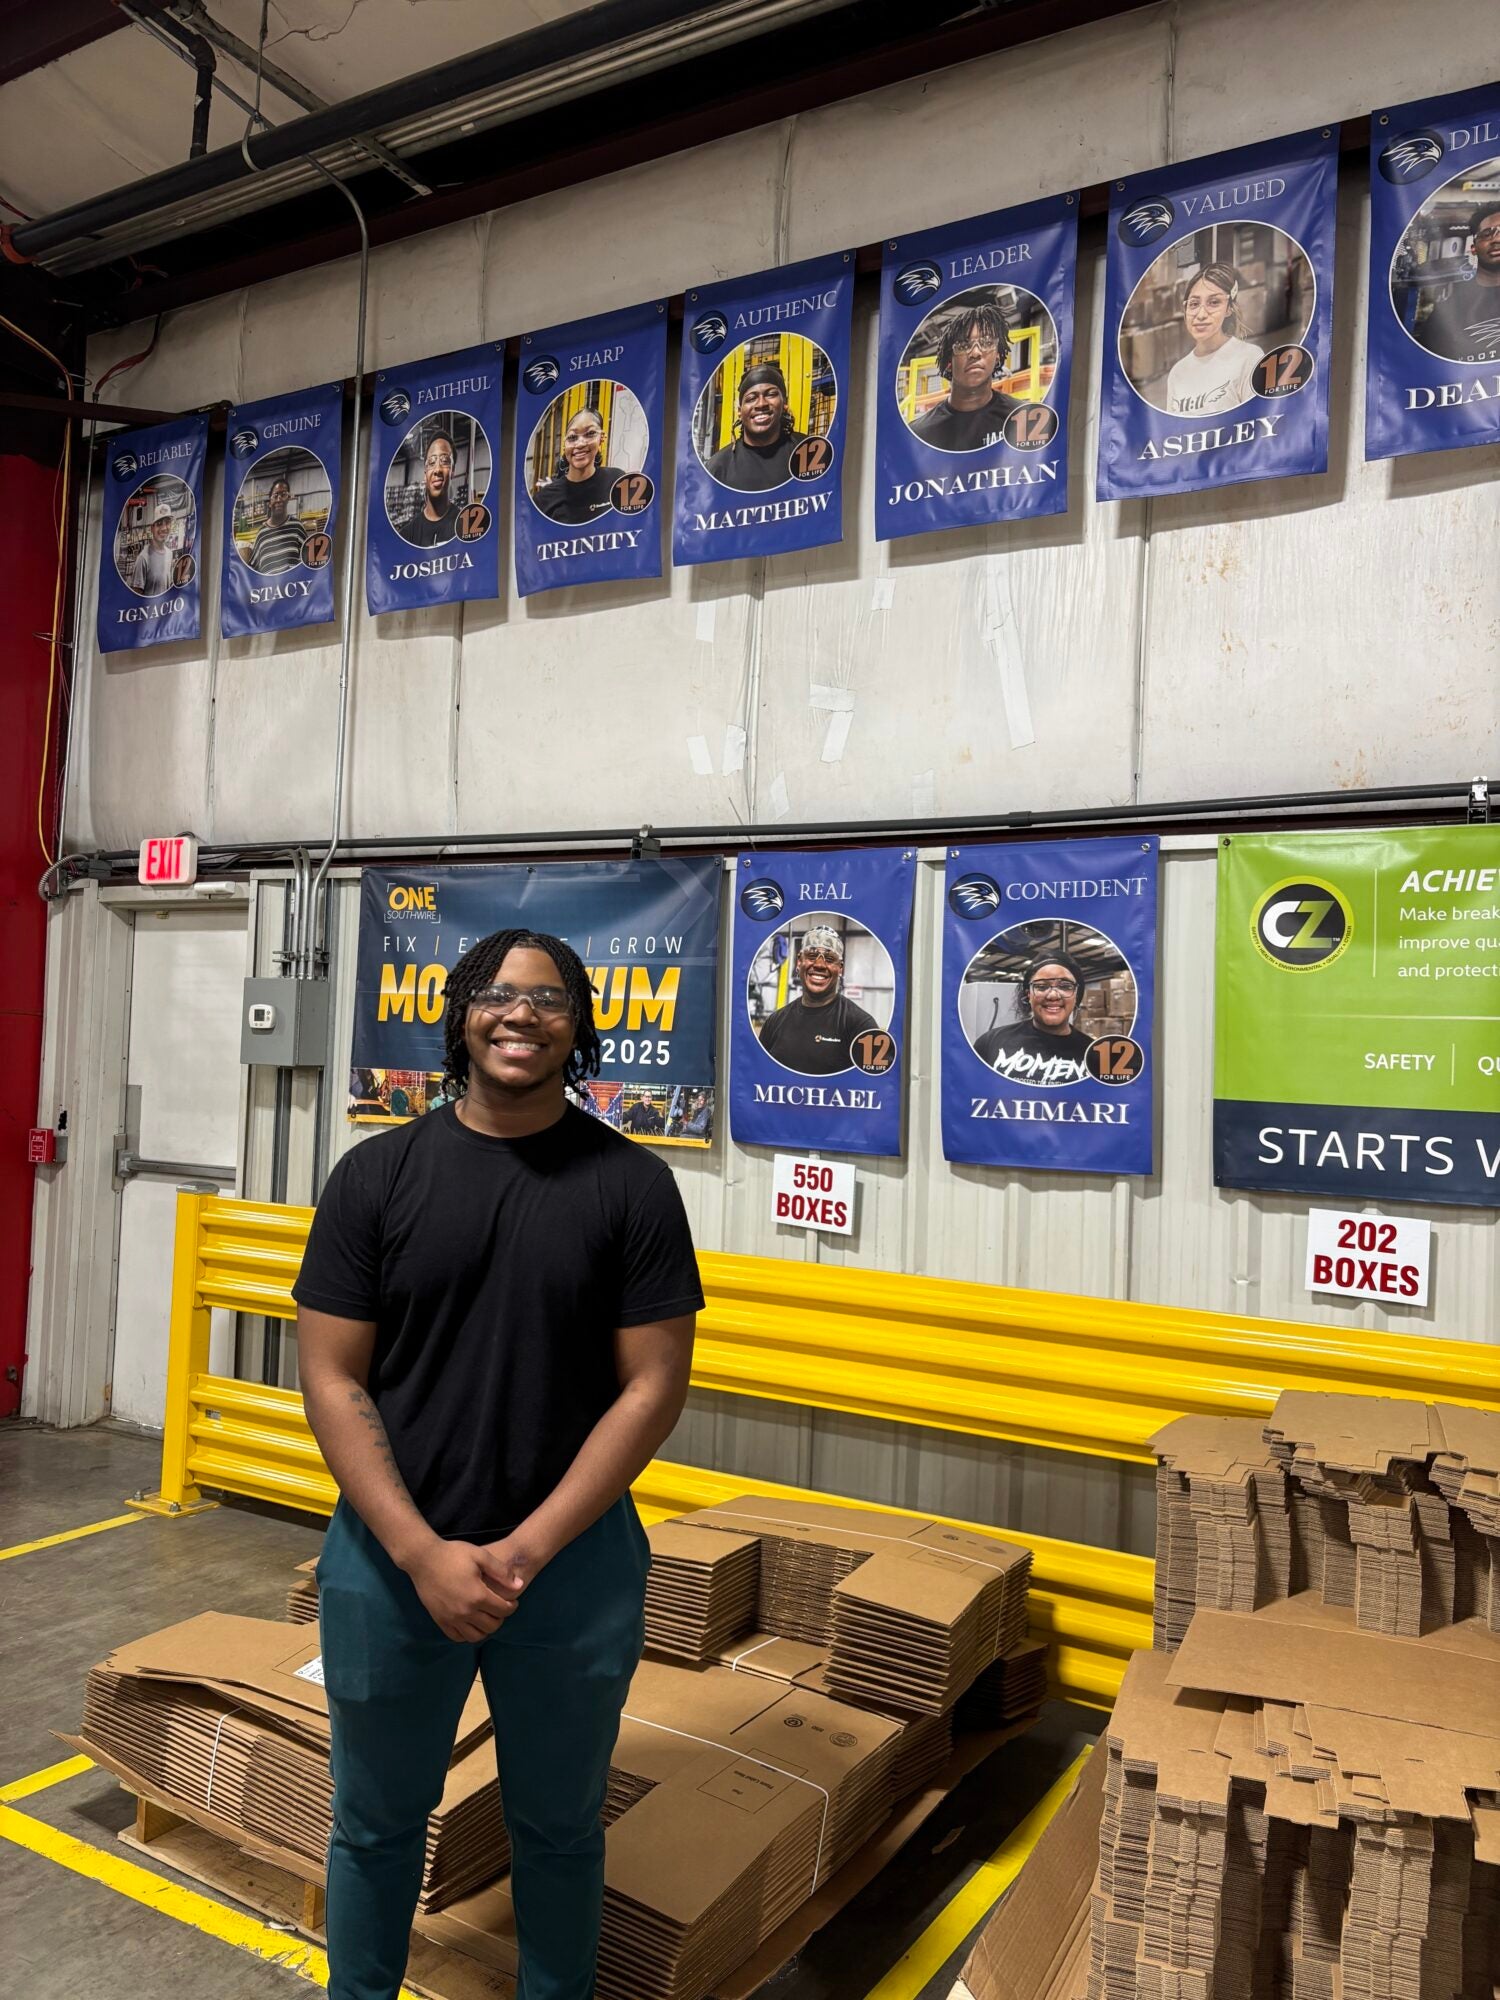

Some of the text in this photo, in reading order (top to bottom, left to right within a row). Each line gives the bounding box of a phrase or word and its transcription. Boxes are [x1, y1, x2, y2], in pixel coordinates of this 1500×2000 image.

[1448, 121, 1499, 152] DIL
[1181, 177, 1286, 217] VALUED
[950, 242, 1033, 279] LEADER
[734, 290, 838, 330] AUTHENIC
[569, 345, 625, 373] SHARP
[1259, 347, 1304, 390] 12
[416, 375, 491, 405] FAITHFUL
[1264, 383, 1299, 395] FOR LIFE
[1404, 375, 1500, 411] DEA
[263, 413, 322, 440] GENUINE
[1010, 407, 1051, 443] 12
[1137, 414, 1285, 461] ASHLEY
[139, 441, 193, 468] RELIABLE
[795, 439, 827, 473] 12
[615, 476, 648, 507] 12
[888, 459, 1060, 506] JONATHAN
[459, 506, 485, 535] 12
[692, 491, 834, 532] MATTHEW
[305, 535, 330, 562] 12
[536, 529, 644, 562] TRINITY
[389, 551, 475, 582] JOSHUA
[249, 579, 314, 605] STACY
[117, 596, 185, 624] IGNACIO
[146, 838, 184, 881] EXIT
[798, 882, 853, 901] REAL
[1005, 876, 1148, 901] CONFIDENT
[1400, 868, 1500, 893] ACHIE
[388, 886, 437, 911] ONE
[1399, 905, 1500, 921] Make break
[386, 910, 437, 920] SOUTHWIRE
[1262, 900, 1336, 949] CZ
[383, 936, 683, 955] FIX GROW
[1399, 935, 1471, 953] improve
[1278, 962, 1323, 972] ENVIRONMENTAL
[1397, 962, 1500, 981] and protect
[601, 1038, 671, 1066] 2025
[858, 1034, 891, 1066] 12
[992, 1046, 1092, 1083] MOMEN
[1092, 1040, 1135, 1075] 12
[1364, 1052, 1436, 1071] SAFETY
[752, 1083, 882, 1111] MICHAEL
[970, 1097, 1131, 1125] ZAHMARI
[1257, 1126, 1455, 1176] STARTS
[793, 1163, 834, 1192] 550
[776, 1192, 848, 1228] BOXES
[1337, 1219, 1398, 1254] 202
[1312, 1254, 1420, 1297] BOXES
